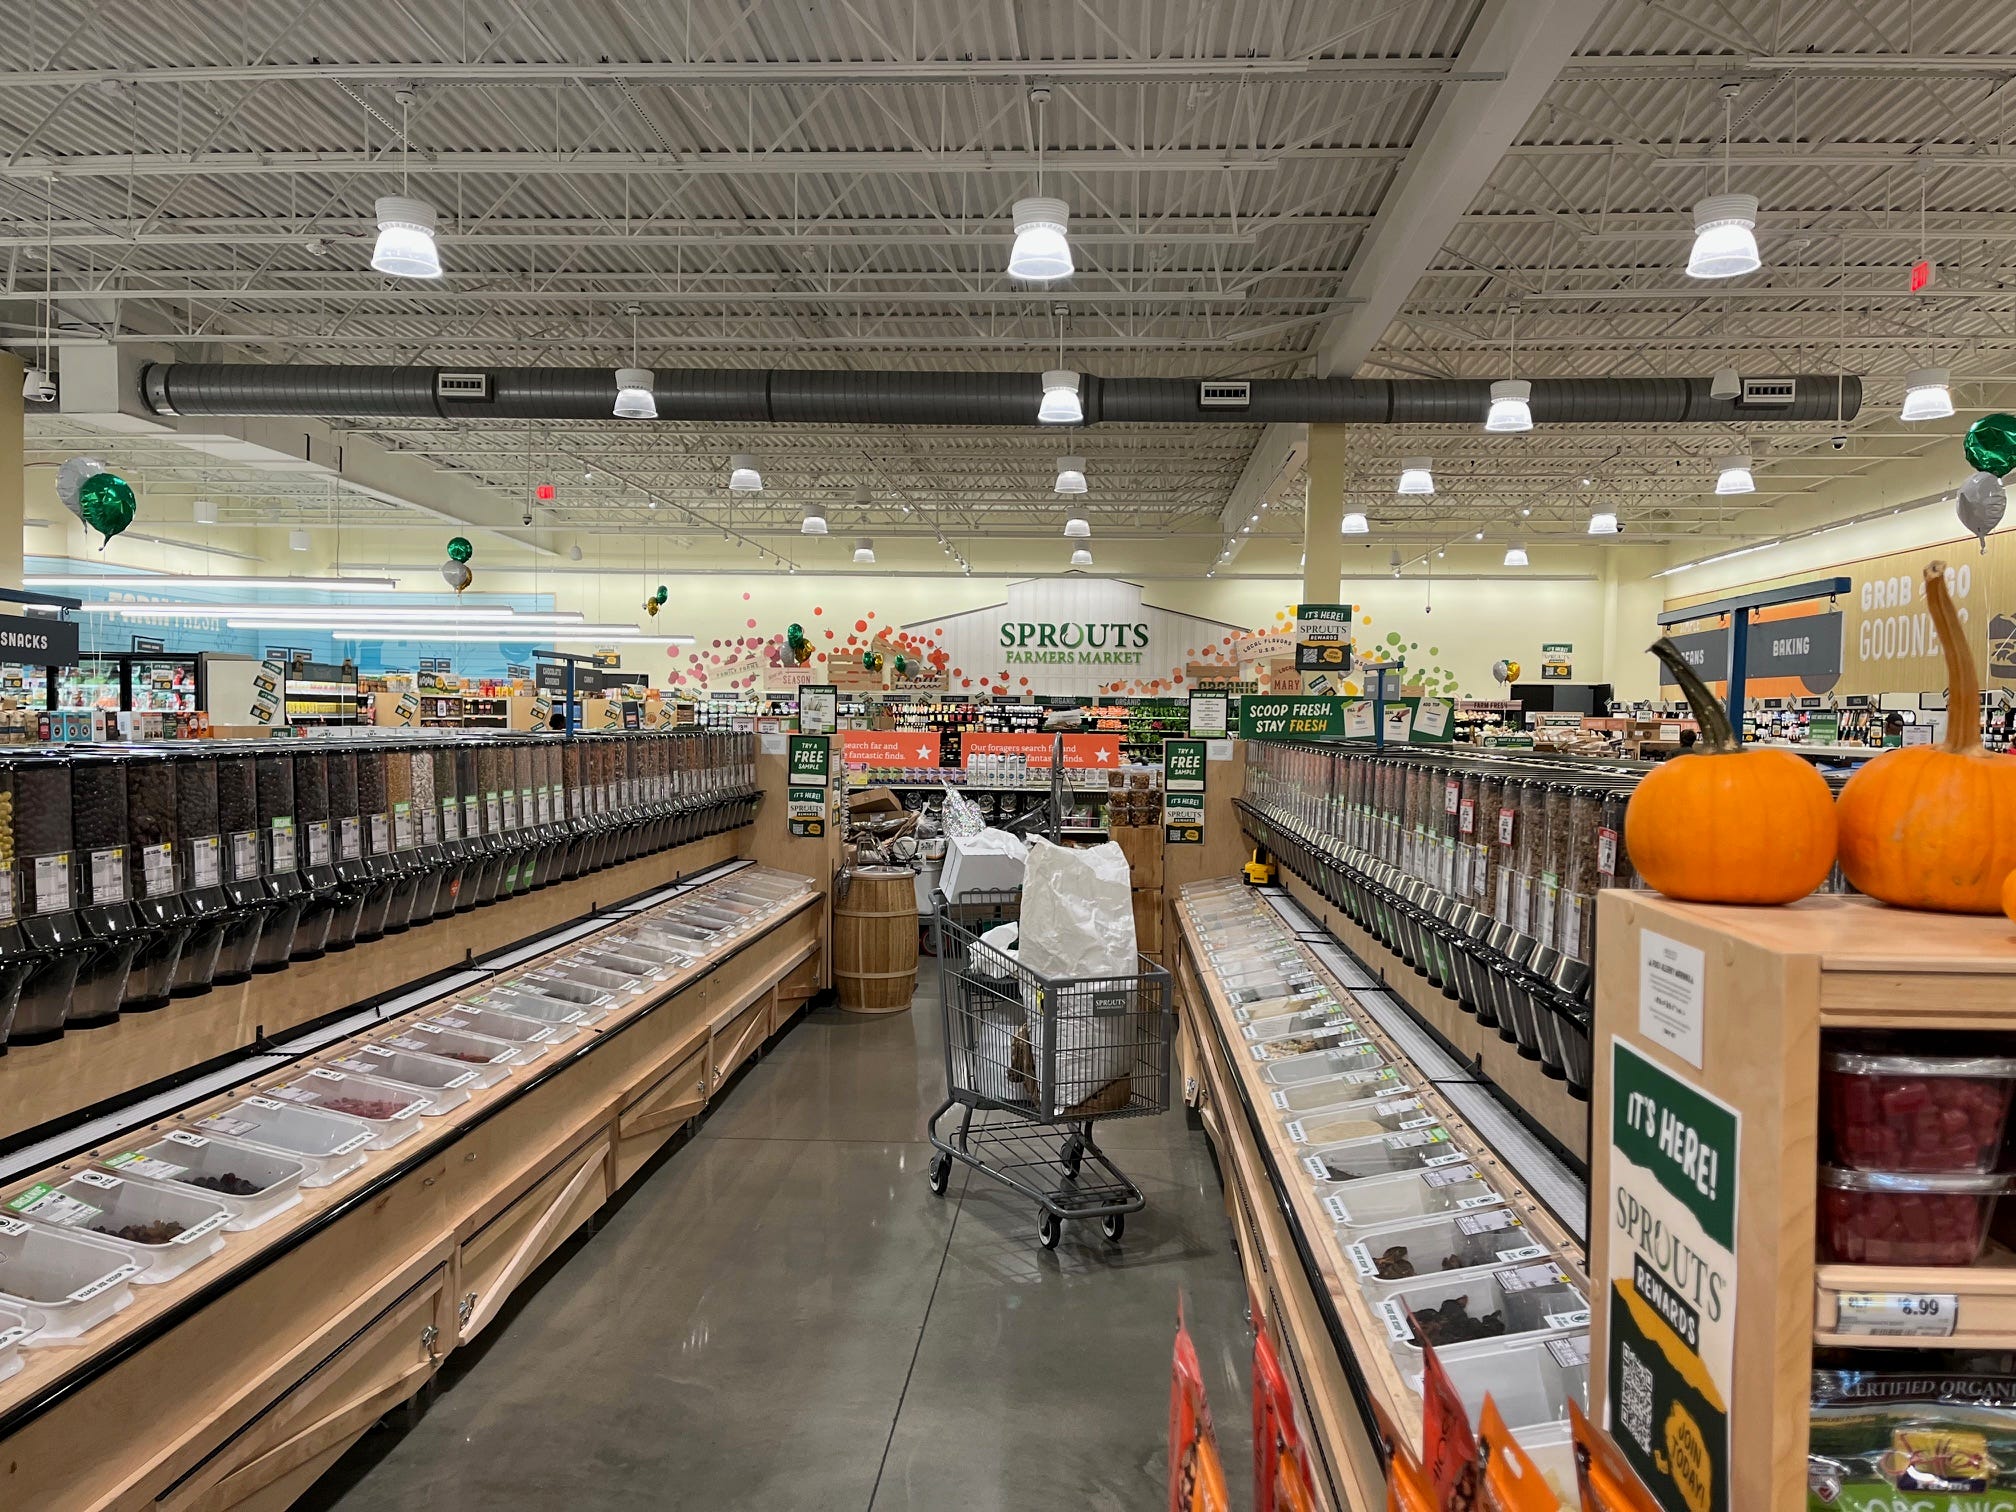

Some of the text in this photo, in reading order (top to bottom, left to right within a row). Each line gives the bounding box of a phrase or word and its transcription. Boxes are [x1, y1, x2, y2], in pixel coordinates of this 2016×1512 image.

[1861, 575, 1912, 612] GRAB
[1305, 610, 1344, 620] IT'S HERE!
[1000, 622, 1149, 649] SPROUTS
[1300, 625, 1347, 634] SPROUTS
[1860, 608, 1969, 662] GOODNE
[0, 632, 48, 650] SNACKS
[1772, 637, 1810, 657] BAKING
[1006, 651, 1143, 664] FARMERS MARKET
[1682, 650, 1705, 665] EANS
[783, 675, 811, 685] SEASON
[1249, 703, 1333, 717] SCOOP FRESH.
[1256, 719, 1328, 733] STAY FRESH
[870, 742, 882, 750] far
[883, 742, 898, 750] and
[970, 744, 986, 752] Our
[988, 743, 1020, 754] foragers
[1021, 744, 1047, 752] search
[794, 750, 824, 763] FREE
[849, 752, 884, 760] fantastic
[885, 752, 905, 760] finds.
[1170, 755, 1200, 768] FREE
[1182, 798, 1199, 806] HERE!
[1095, 999, 1125, 1007] SPROUTS
[1627, 1091, 1718, 1201] IT'S HERE!
[1616, 1186, 1723, 1323] SPROUTS
[1637, 1265, 1696, 1345] REWARDS
[1841, 1380, 1936, 1397] CERTIFIED
[1679, 1422, 1701, 1469] JOIN
[1673, 1436, 1705, 1508] TODAY!
